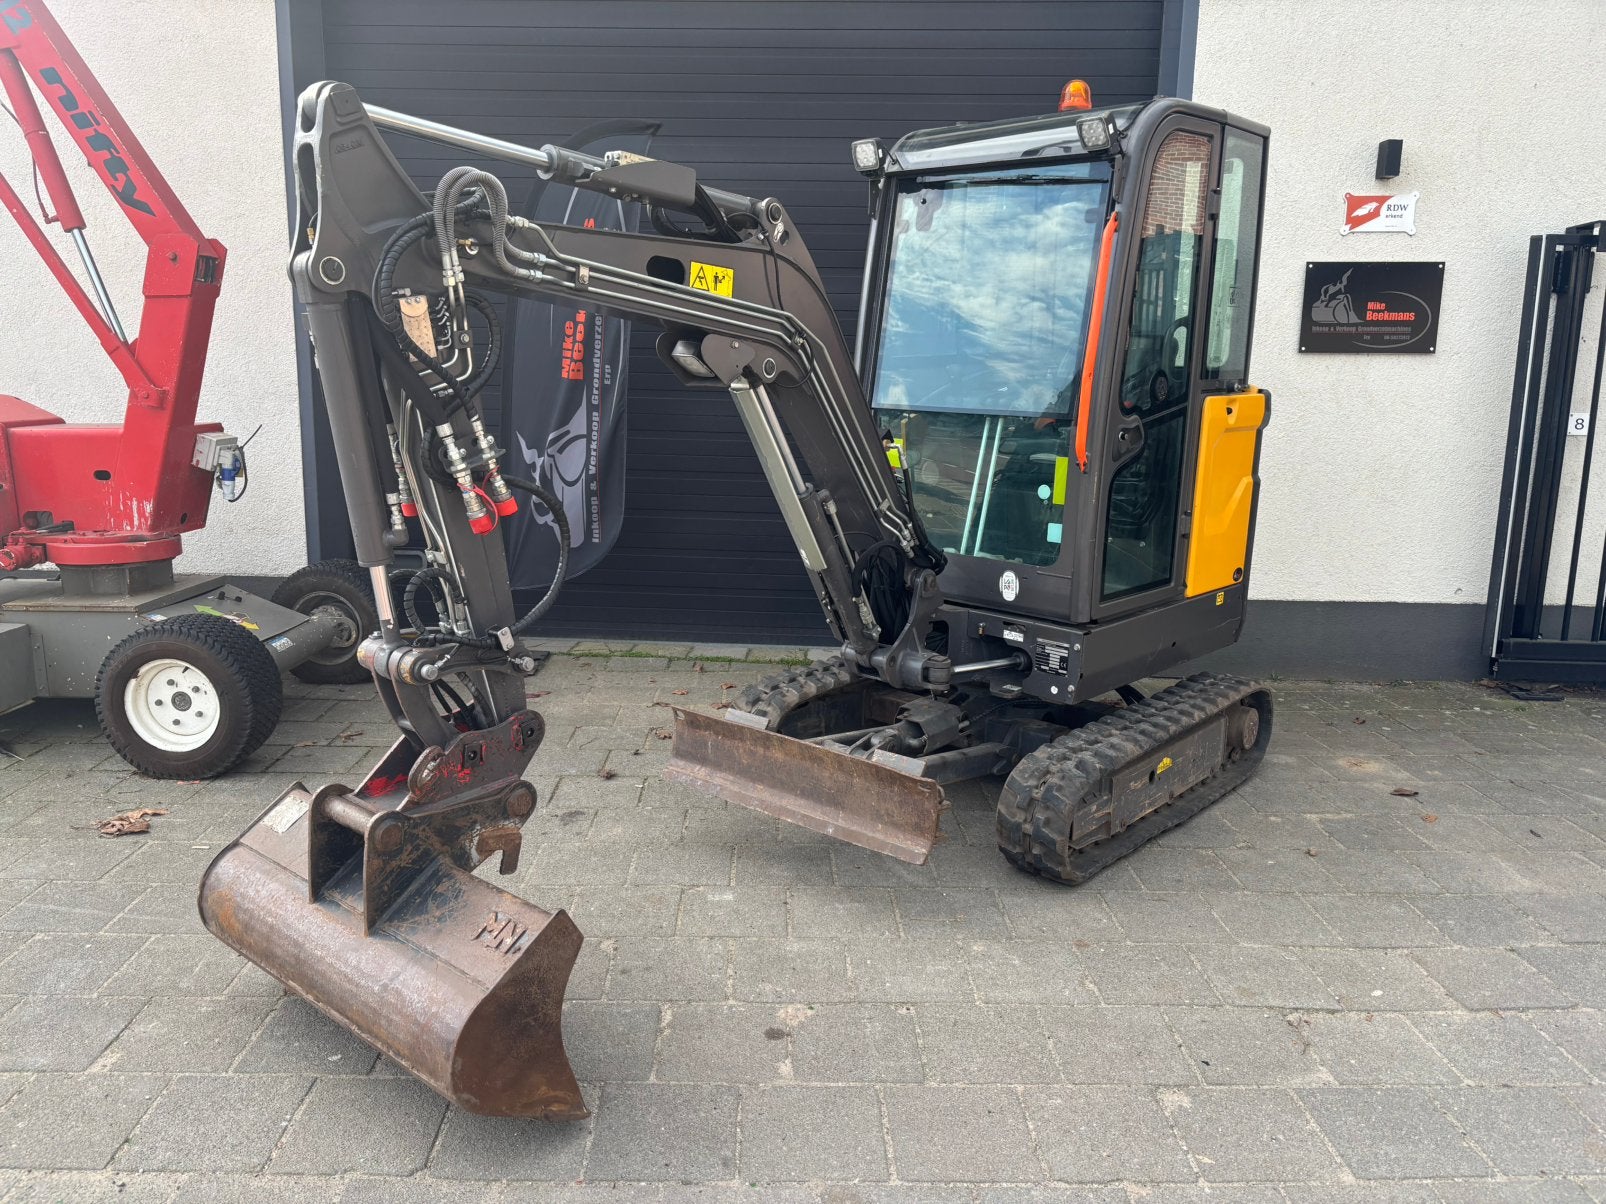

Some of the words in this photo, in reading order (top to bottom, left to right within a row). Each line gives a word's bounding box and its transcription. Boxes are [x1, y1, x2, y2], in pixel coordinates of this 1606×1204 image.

[39, 66, 157, 217] nifty
[1386, 203, 1409, 212] RDW
[1366, 311, 1416, 321] Beekmans
[1367, 301, 1386, 310] Mike
[561, 320, 575, 379] Mike
[568, 309, 587, 381] Beek
[591, 313, 604, 405] Grondverze
[604, 364, 612, 385] Erp
[1574, 417, 1585, 430] 8
[589, 411, 600, 475] Verkoop
[590, 483, 598, 491] &
[591, 495, 600, 543] Inkoop
